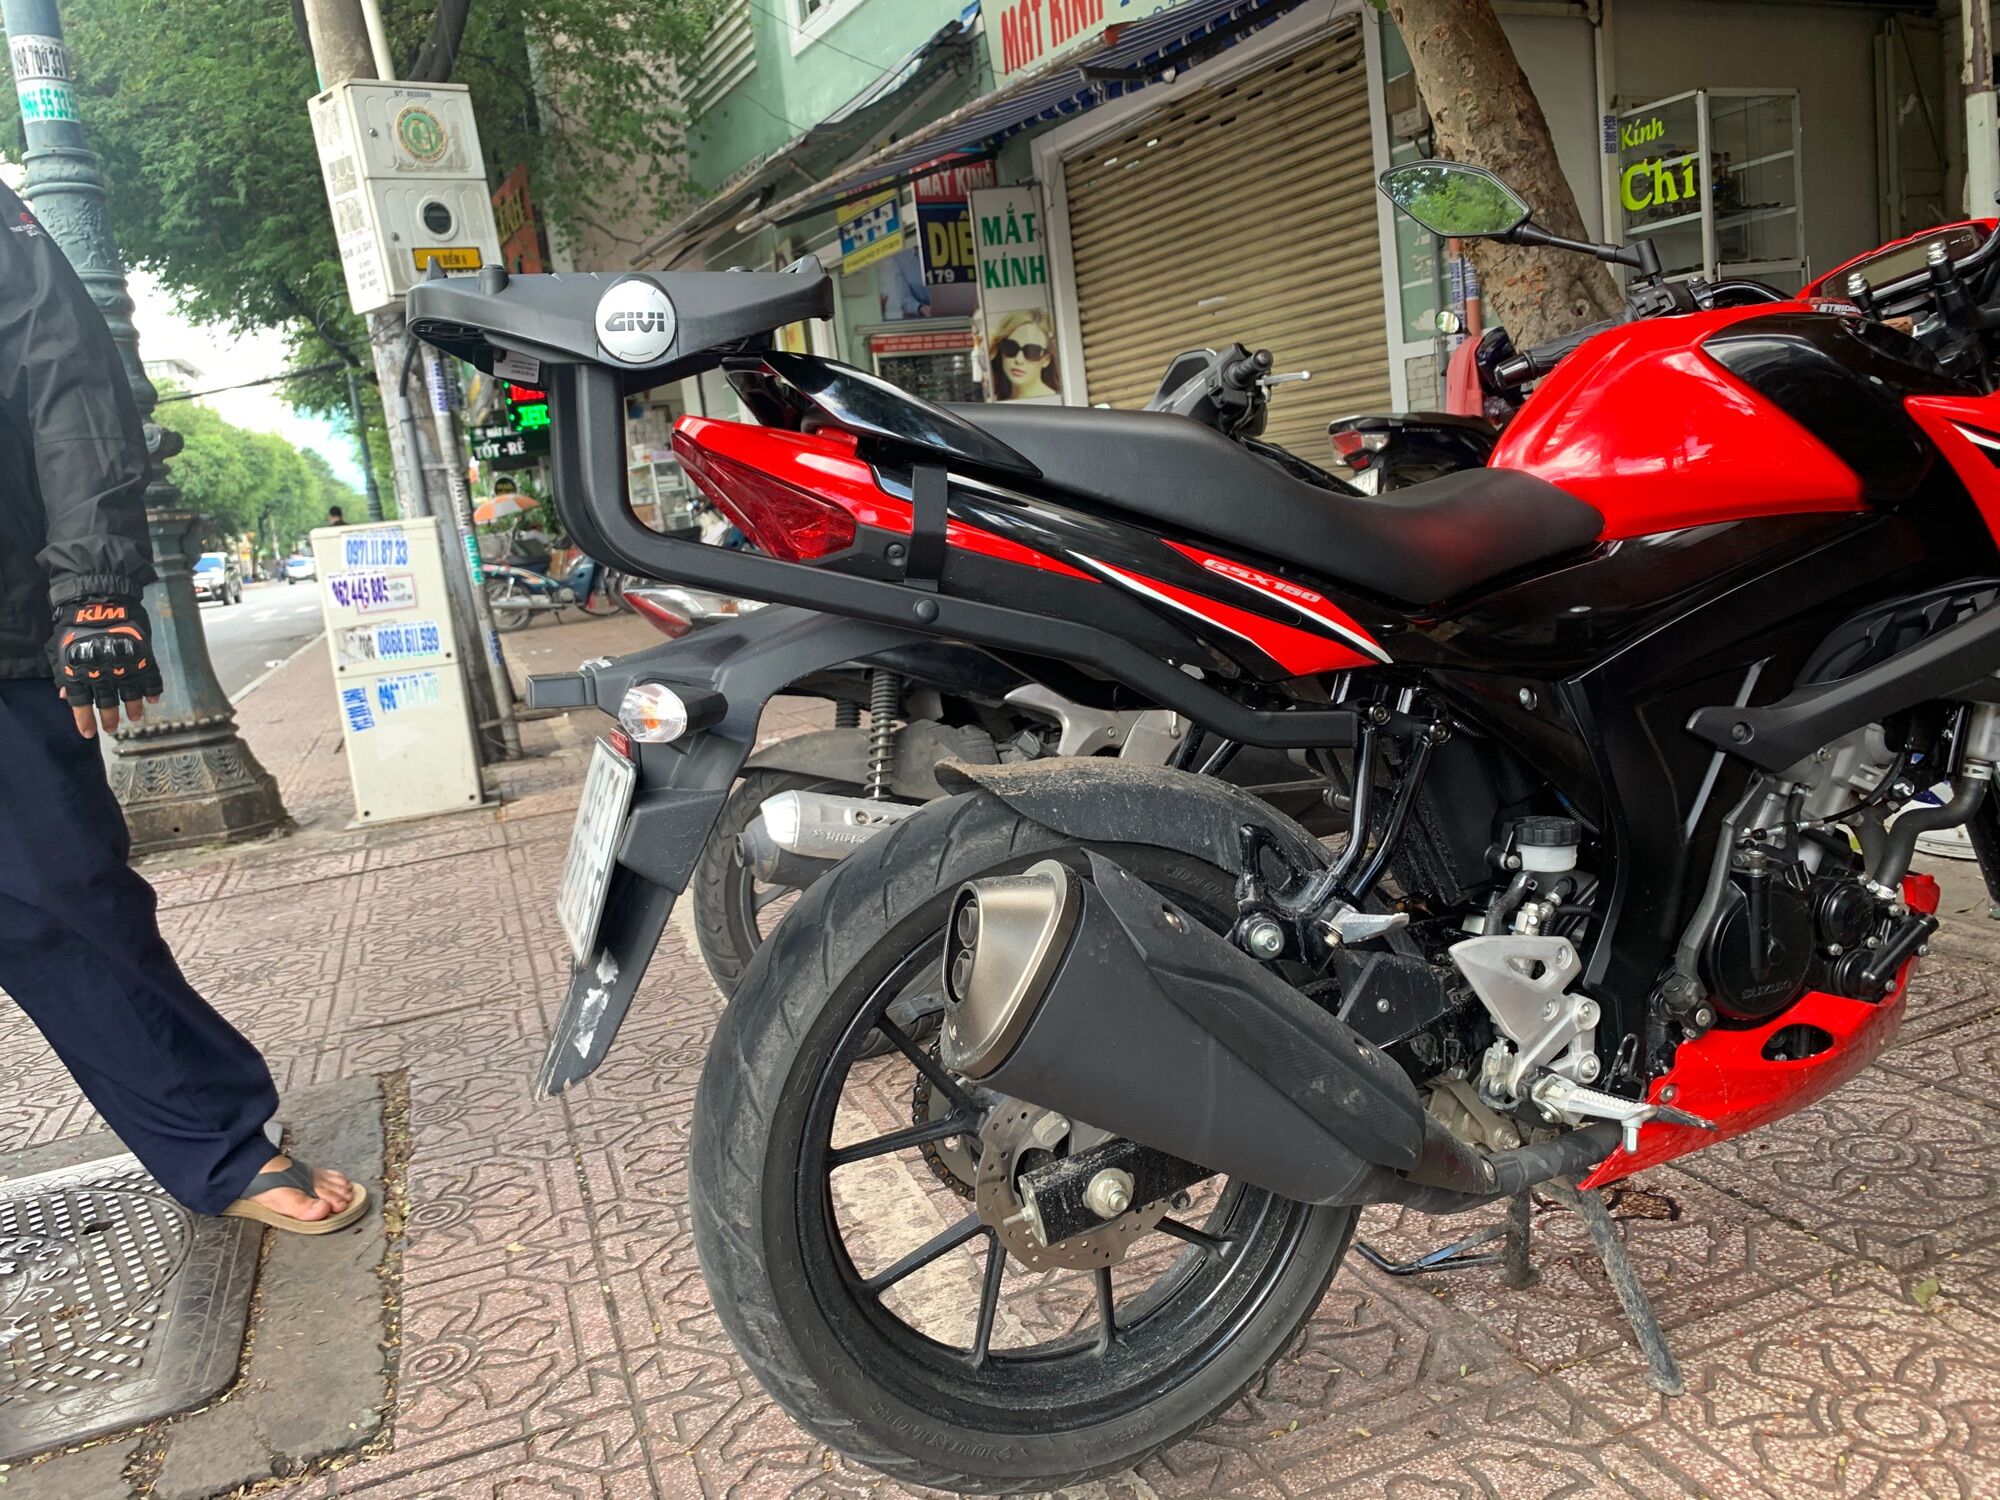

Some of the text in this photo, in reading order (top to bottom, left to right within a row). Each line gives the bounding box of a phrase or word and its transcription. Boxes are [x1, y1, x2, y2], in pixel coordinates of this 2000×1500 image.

[1621, 117, 1665, 151] Kính
[1621, 156, 1696, 211] Chi
[981, 202, 1037, 247] MẮT
[983, 252, 1046, 289] KÍNH
[605, 312, 665, 333] GIVI
[1203, 559, 1322, 603] GSX150
[75, 603, 126, 623] KTM
